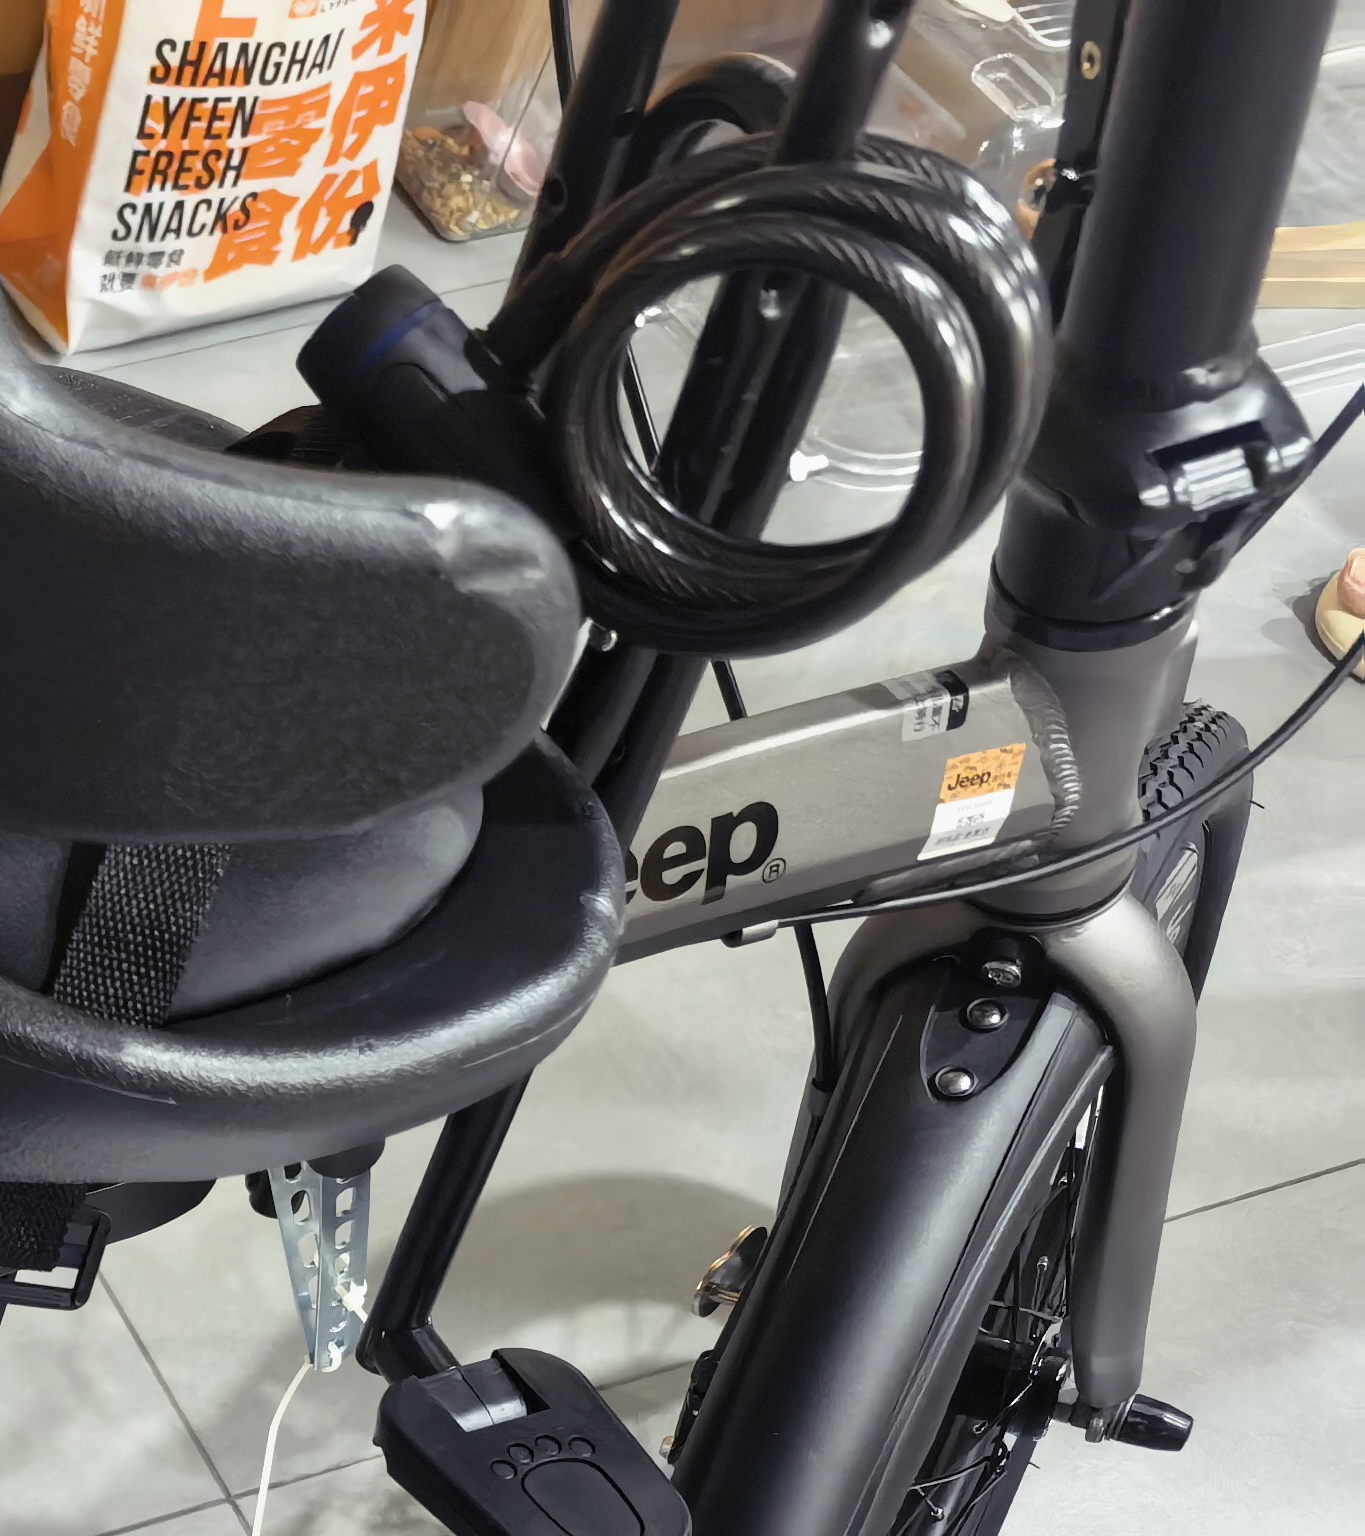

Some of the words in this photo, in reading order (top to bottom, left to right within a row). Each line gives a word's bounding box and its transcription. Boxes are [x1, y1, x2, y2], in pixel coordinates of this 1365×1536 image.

[149, 27, 346, 88] SHANGHAI
[135, 94, 260, 141] LYFEN
[123, 147, 251, 194] FRESH
[111, 191, 259, 243] SNACKS
[946, 770, 992, 792] Jeep
